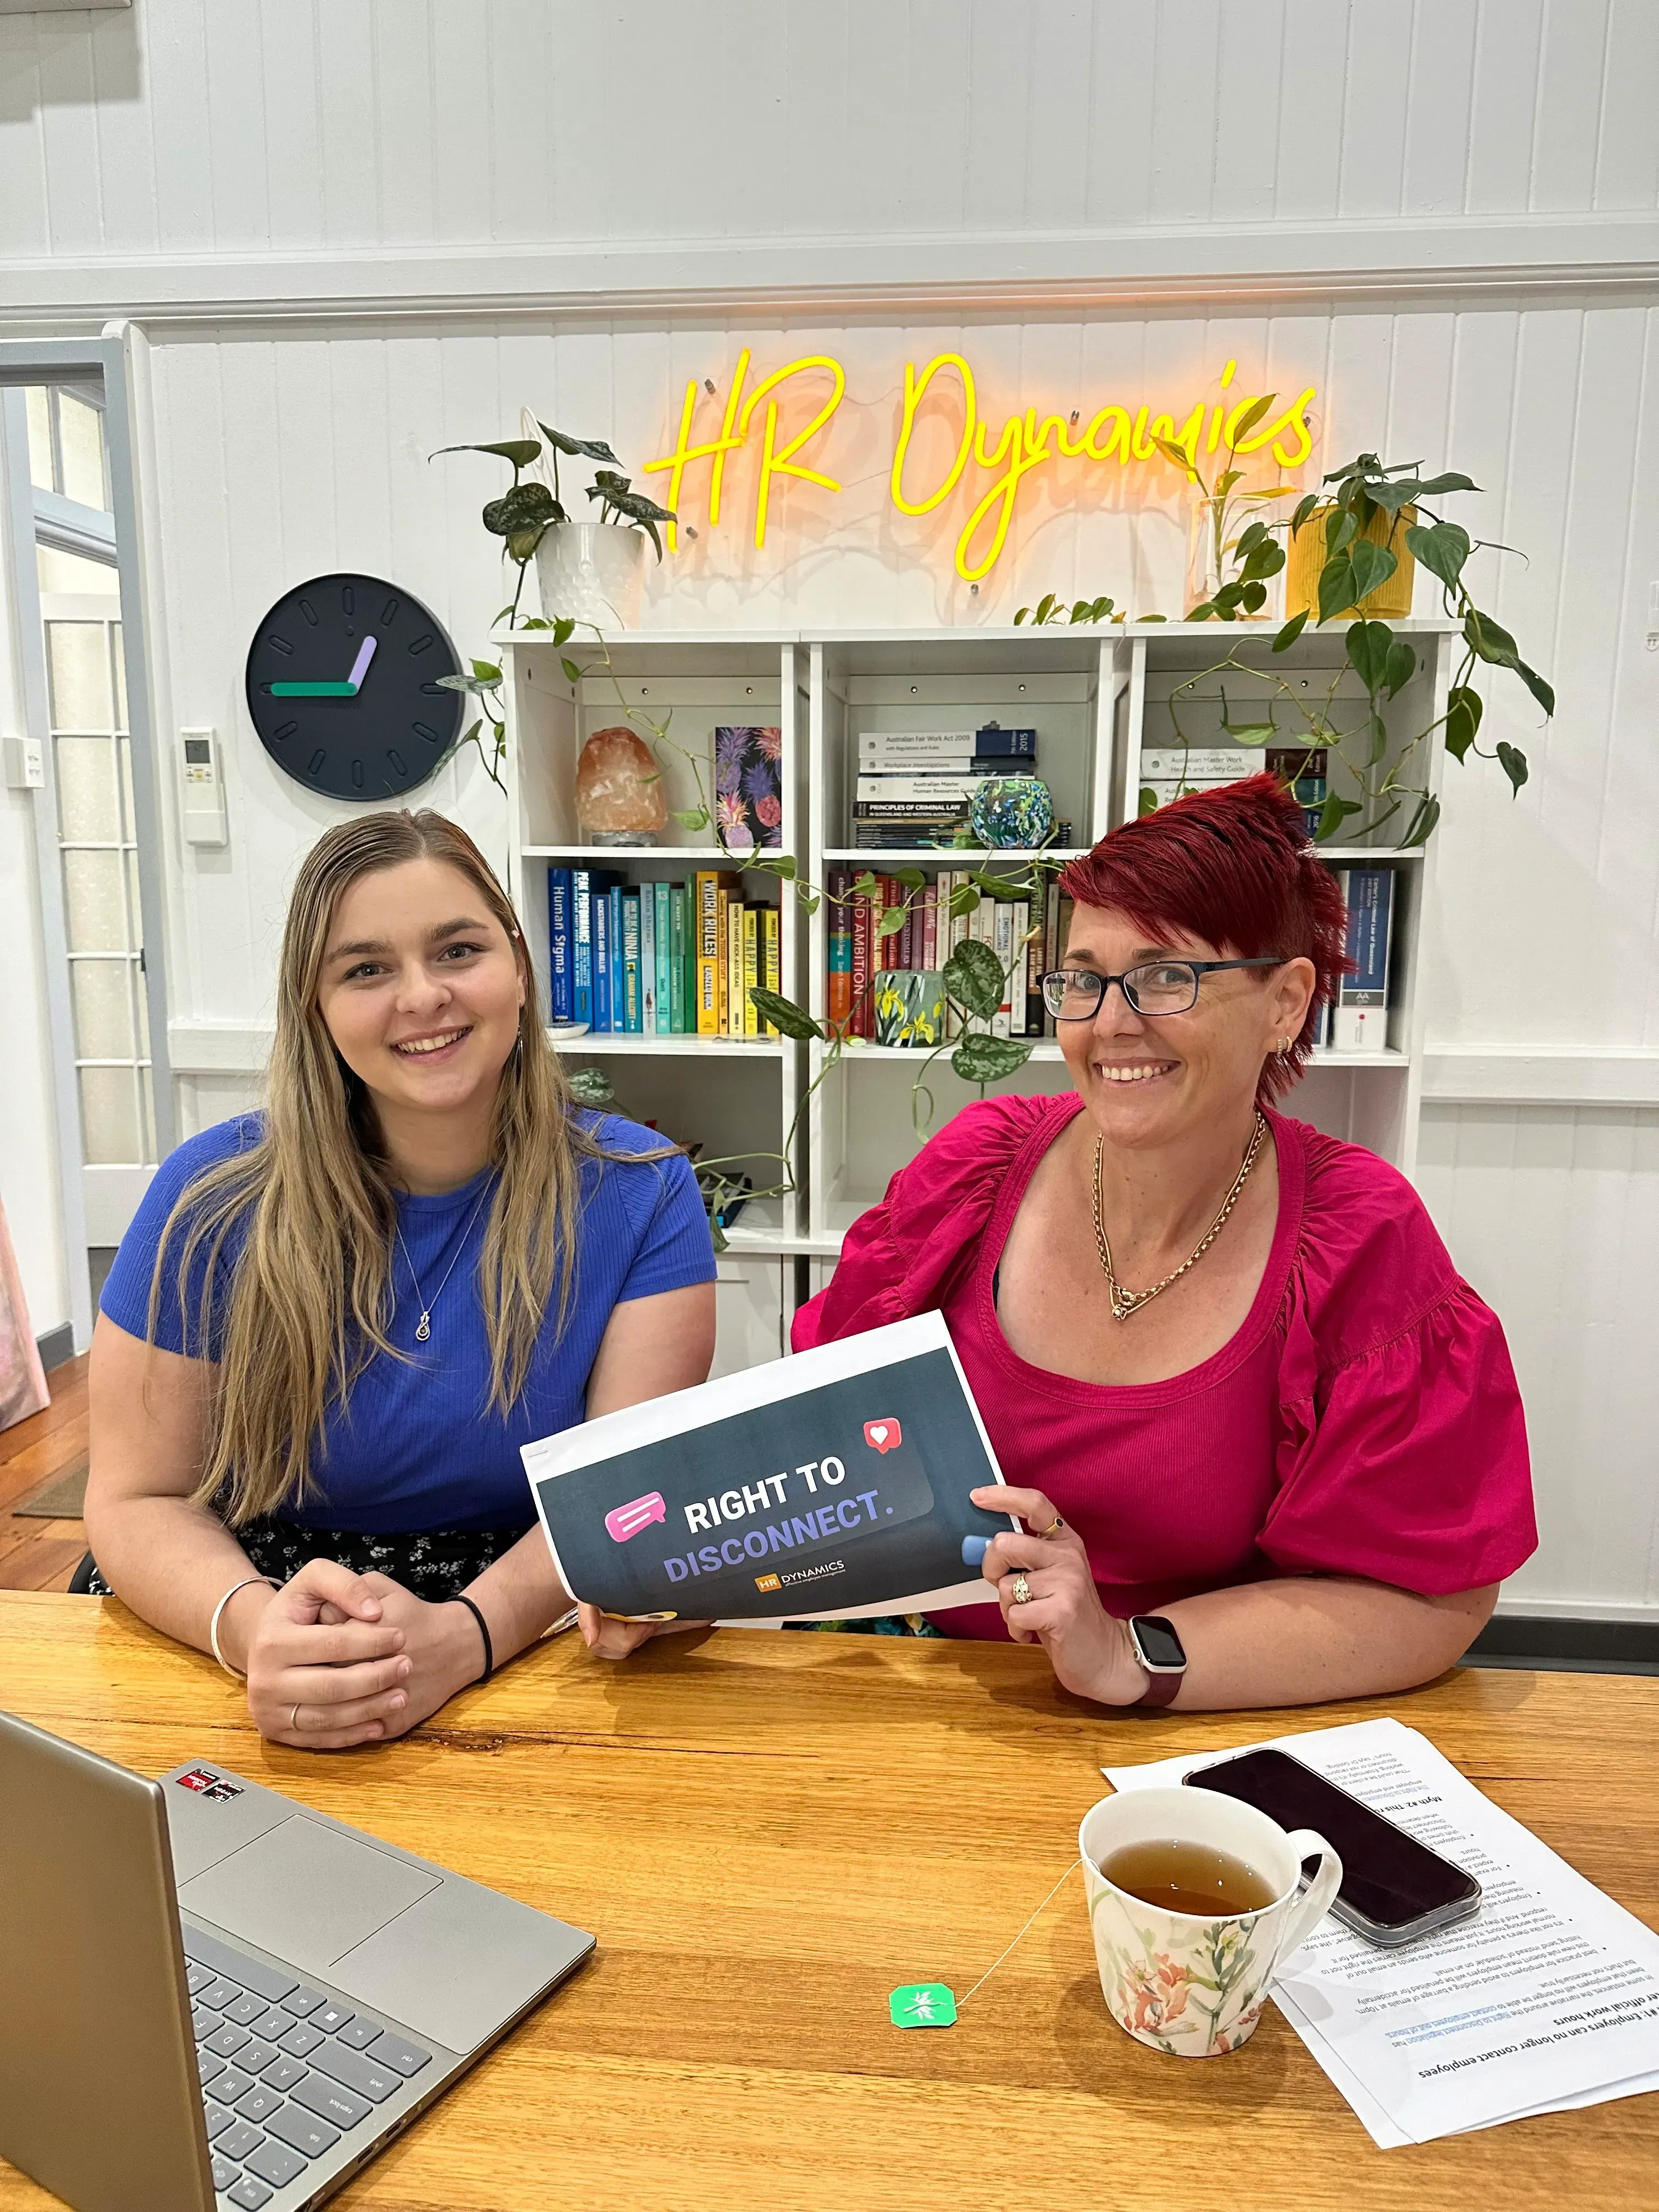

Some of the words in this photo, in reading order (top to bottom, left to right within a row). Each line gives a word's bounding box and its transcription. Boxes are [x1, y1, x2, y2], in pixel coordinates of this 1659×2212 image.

[643, 348, 845, 553] HR
[891, 352, 1316, 581] Dynamics
[1020, 733, 1028, 751] 2015
[577, 872, 589, 890] PEAK
[703, 881, 717, 915] WORK
[553, 887, 565, 929] Human
[578, 893, 590, 944] PERFORMANCE
[703, 917, 718, 959] RULES!
[837, 926, 845, 956] thinking
[624, 932, 637, 960] NINJA
[552, 935, 566, 973] Sigma
[745, 939, 756, 973] HAPPY
[767, 939, 778, 973] HAPPY
[854, 924, 865, 995] AMBITION
[684, 1472, 788, 1534] RIGHT
[795, 1456, 845, 1493] TO
[663, 1490, 894, 1584] DISCONNECT.
[759, 1579, 777, 1588] HR
[781, 1560, 844, 1583] DYNAMICS
[1418, 1796, 1442, 1804] Myth
[1555, 1952, 1582, 1963] practice
[1466, 1965, 1503, 1977] employers
[1509, 1963, 1545, 1976] employers
[1410, 1978, 1444, 1993] penalised
[1452, 1979, 1482, 1990] sending
[1481, 1975, 1501, 1984] avoid
[1357, 1991, 1398, 2005] accidentally
[1420, 1989, 1449, 1999] barrage
[241, 2004, 251, 2012] C
[1387, 1998, 1411, 2007] emails
[1611, 1998, 1646, 2012] official
[1553, 2014, 1587, 2025] hours
[1583, 2007, 1612, 2018] work
[1588, 2013, 1643, 2030] Employers
[1568, 2028, 1588, 2036] can
[1520, 2036, 1555, 2049] longer
[251, 2052, 261, 2060] S
[402, 2054, 413, 2063] ctrl
[1477, 2046, 1518, 2062] contact
[280, 2068, 290, 2077] A
[1419, 2058, 1476, 2078] employees
[223, 2080, 235, 2091] W
[370, 2078, 384, 2089] shift
[253, 2098, 263, 2108] Q
